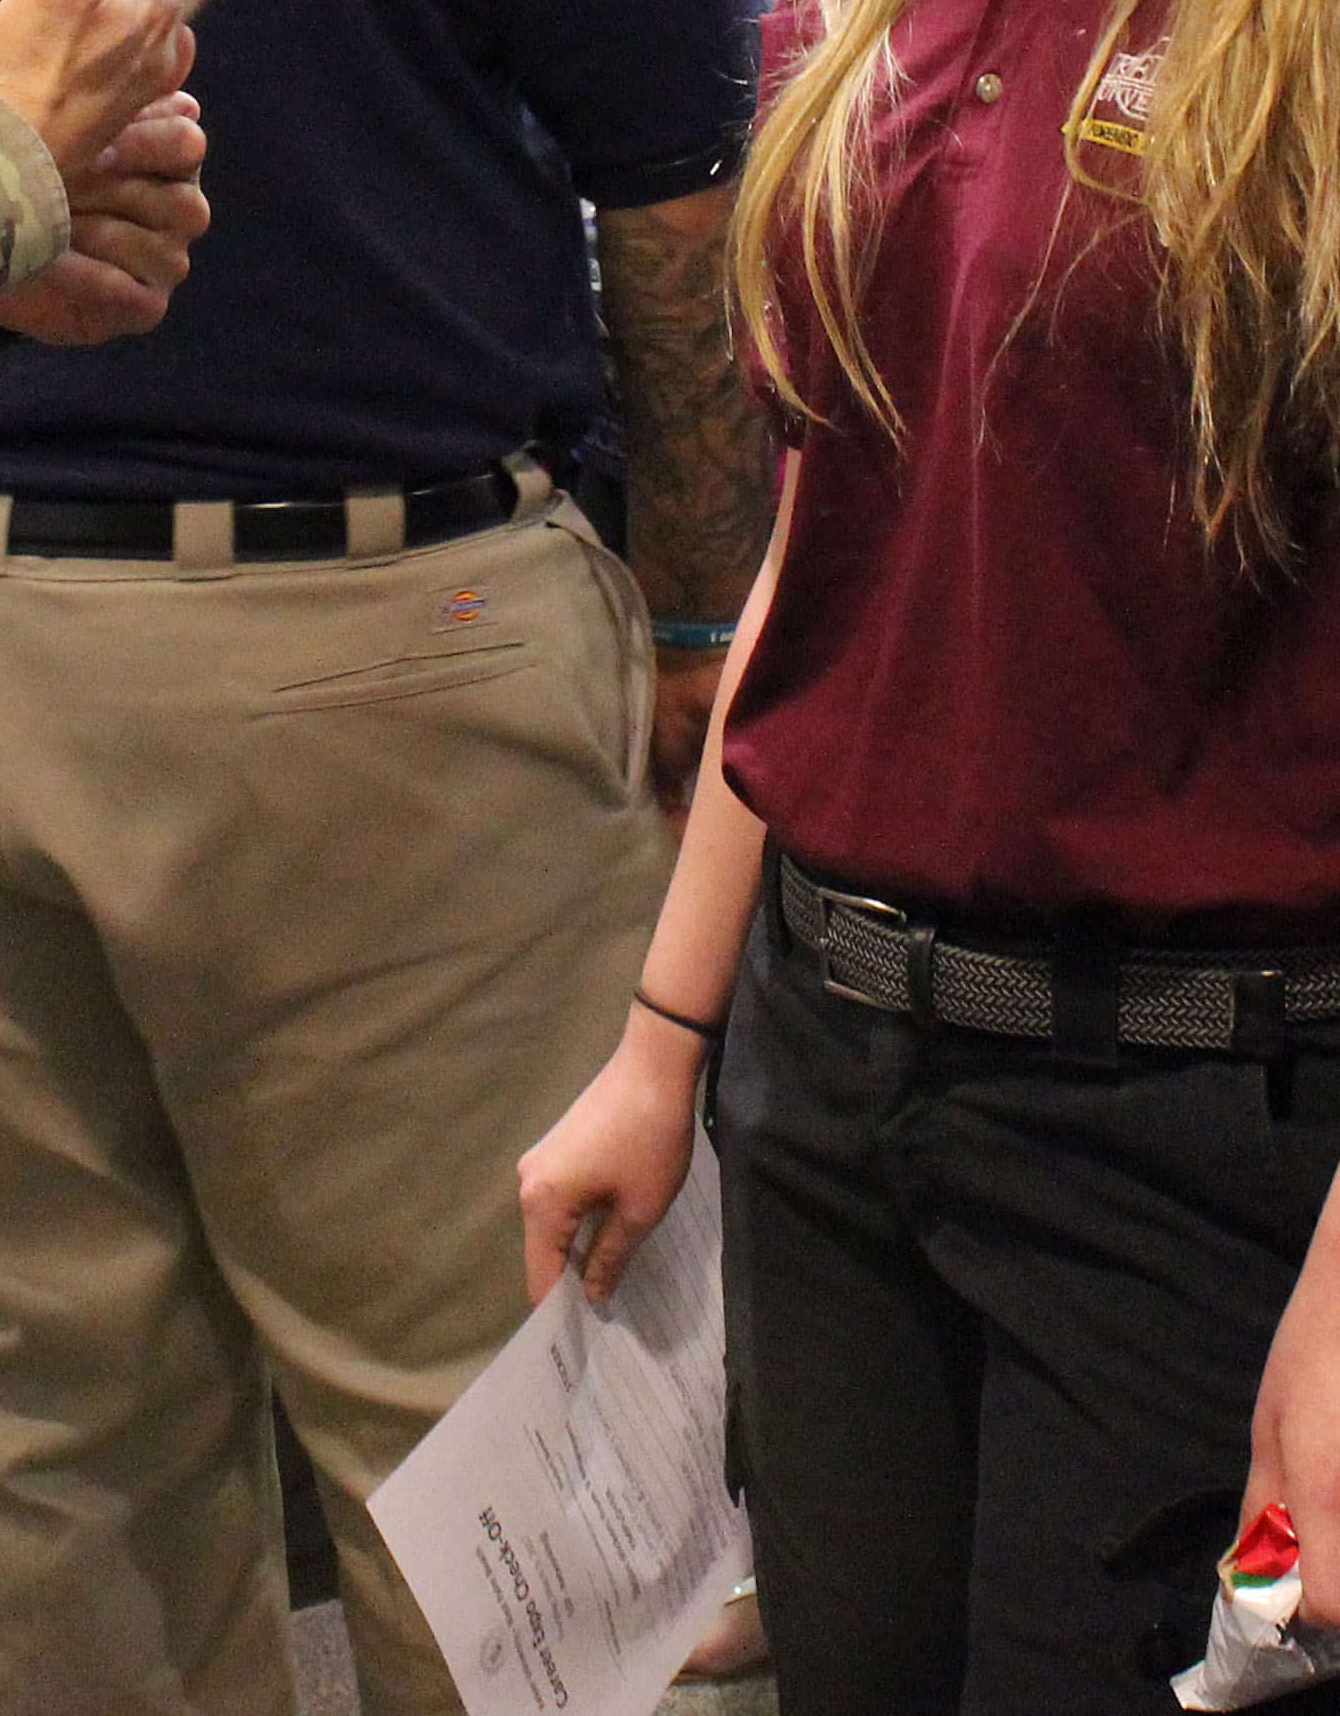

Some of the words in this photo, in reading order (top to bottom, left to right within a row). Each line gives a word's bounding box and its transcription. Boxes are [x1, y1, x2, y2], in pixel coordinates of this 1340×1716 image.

[477, 1506, 530, 1603] Check-Off
[525, 1599, 546, 1649] Expo
[538, 1646, 569, 1708] Career
